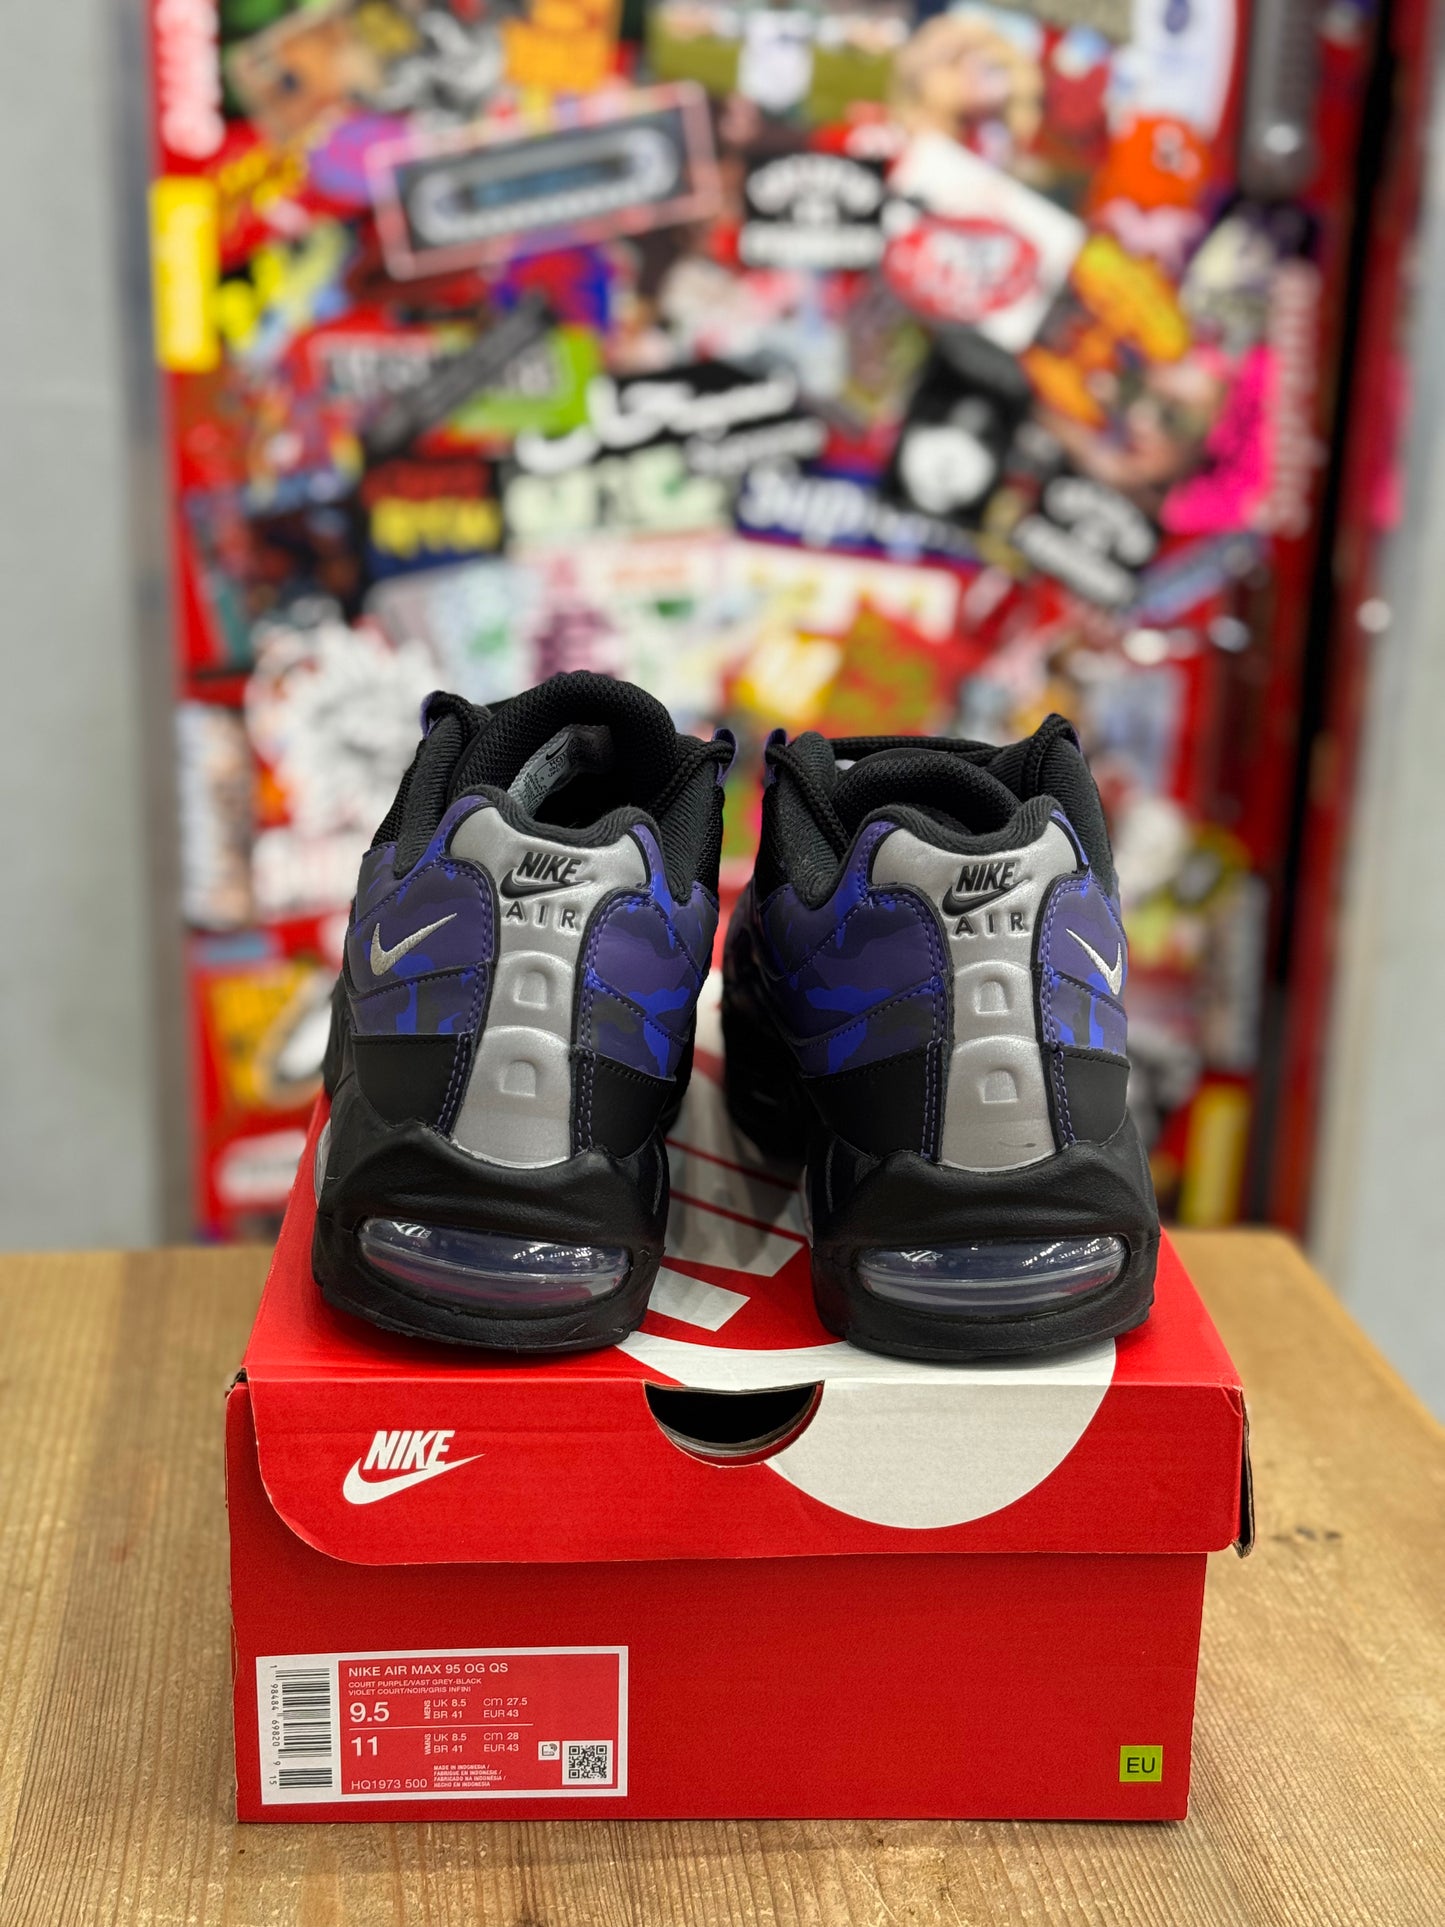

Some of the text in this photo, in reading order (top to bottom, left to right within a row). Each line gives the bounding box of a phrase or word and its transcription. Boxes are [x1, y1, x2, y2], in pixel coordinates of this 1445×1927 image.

[516, 851, 582, 883] NIKE
[956, 862, 1016, 893] NIKE
[506, 900, 577, 929] AIR
[955, 912, 1024, 935] AIR
[363, 1430, 455, 1470] NIKE
[348, 1662, 509, 1677] NIKE AIR MAX 95 OG QS
[348, 1681, 375, 1689] COURT
[378, 1679, 430, 1687] PURPLE/VAST
[378, 1687, 447, 1695] COURT/NOIR/GRIS
[271, 1684, 279, 1711] 98484
[433, 1698, 467, 1707] UK 8.5
[507, 1697, 528, 1706] 27.5
[350, 1701, 390, 1723] 9.5
[433, 1710, 463, 1719] BR 41
[484, 1709, 519, 1718] EUR 43
[272, 1720, 280, 1747] 69820
[434, 1733, 467, 1742] UK 8.5
[507, 1732, 519, 1740] 28
[351, 1736, 378, 1757] 11
[434, 1745, 463, 1753] BR 41
[484, 1743, 519, 1752] EUR 43
[1126, 1757, 1155, 1774] EU
[269, 1776, 277, 1785] 15
[351, 1778, 428, 1790] HQ1973 500
